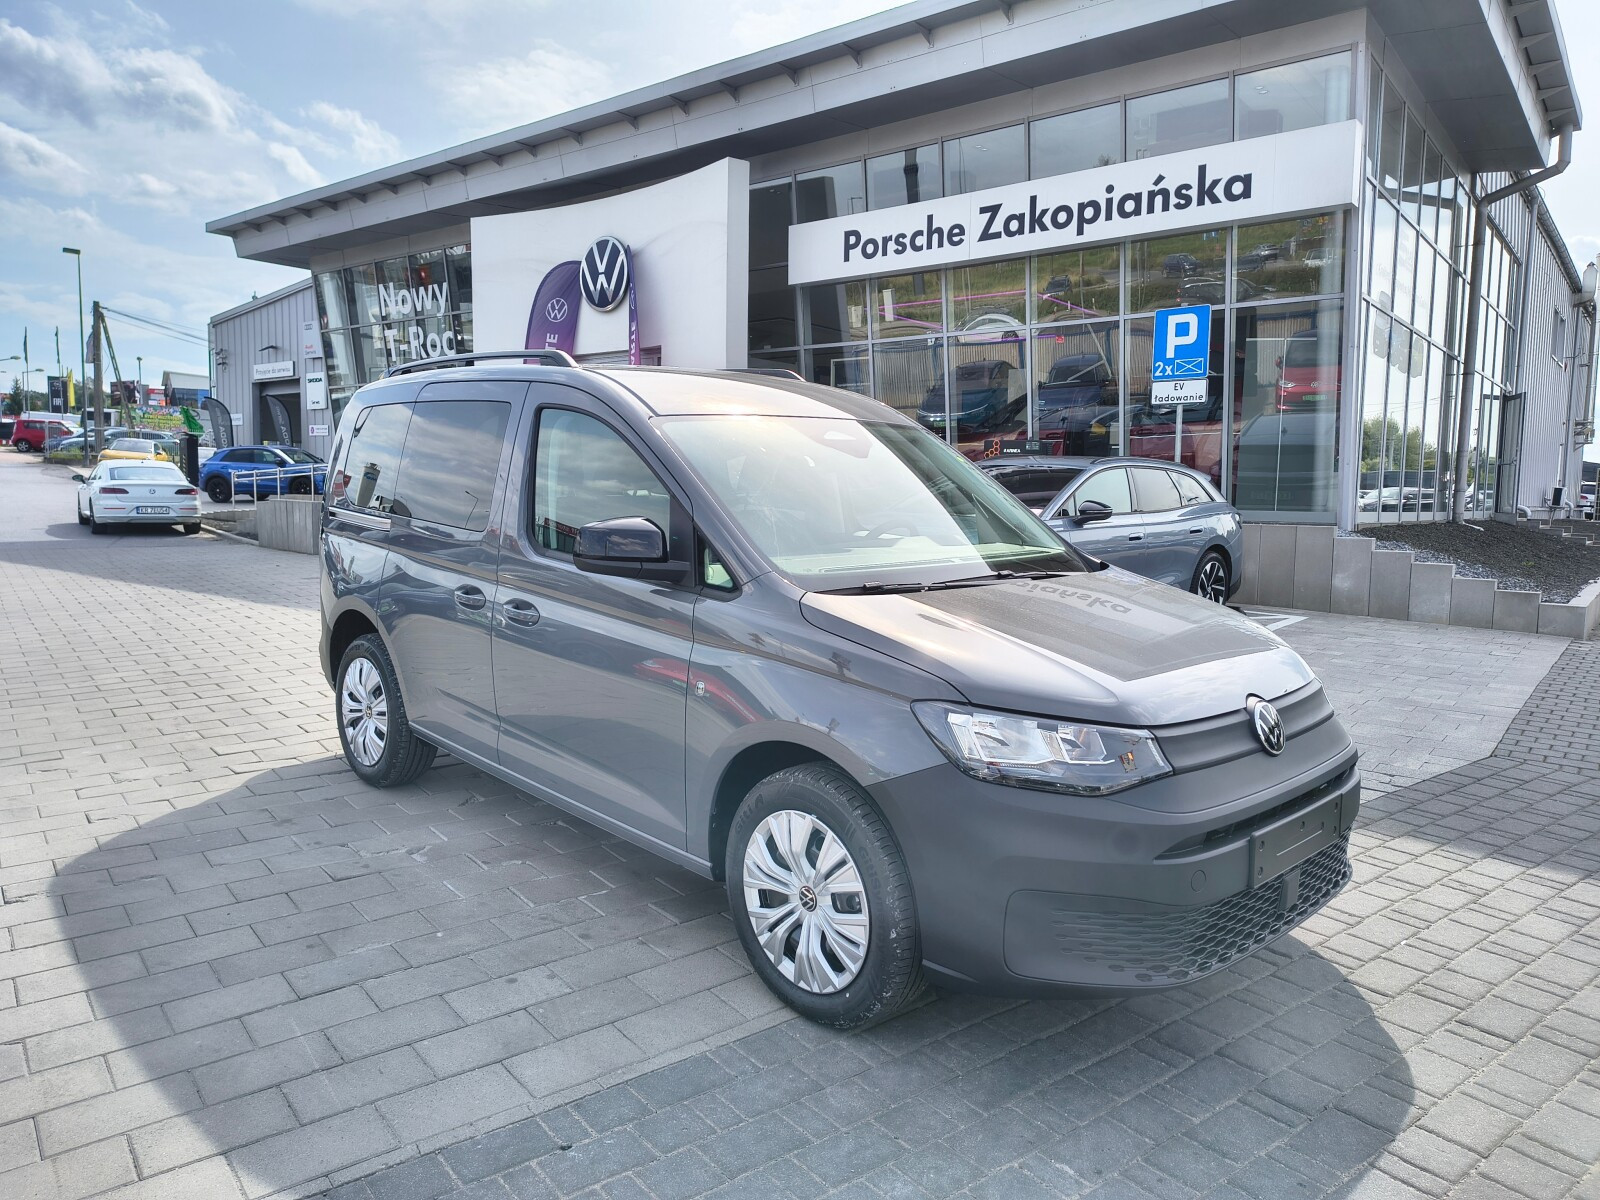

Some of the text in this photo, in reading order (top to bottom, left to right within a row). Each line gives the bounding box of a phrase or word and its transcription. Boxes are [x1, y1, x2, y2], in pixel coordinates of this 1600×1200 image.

[843, 164, 1253, 263] Porsche Zakopiańska
[378, 281, 449, 318] Nowy
[384, 325, 456, 362] T-Roc
[1166, 313, 1198, 358] P
[1154, 393, 1204, 402] ładowanie
